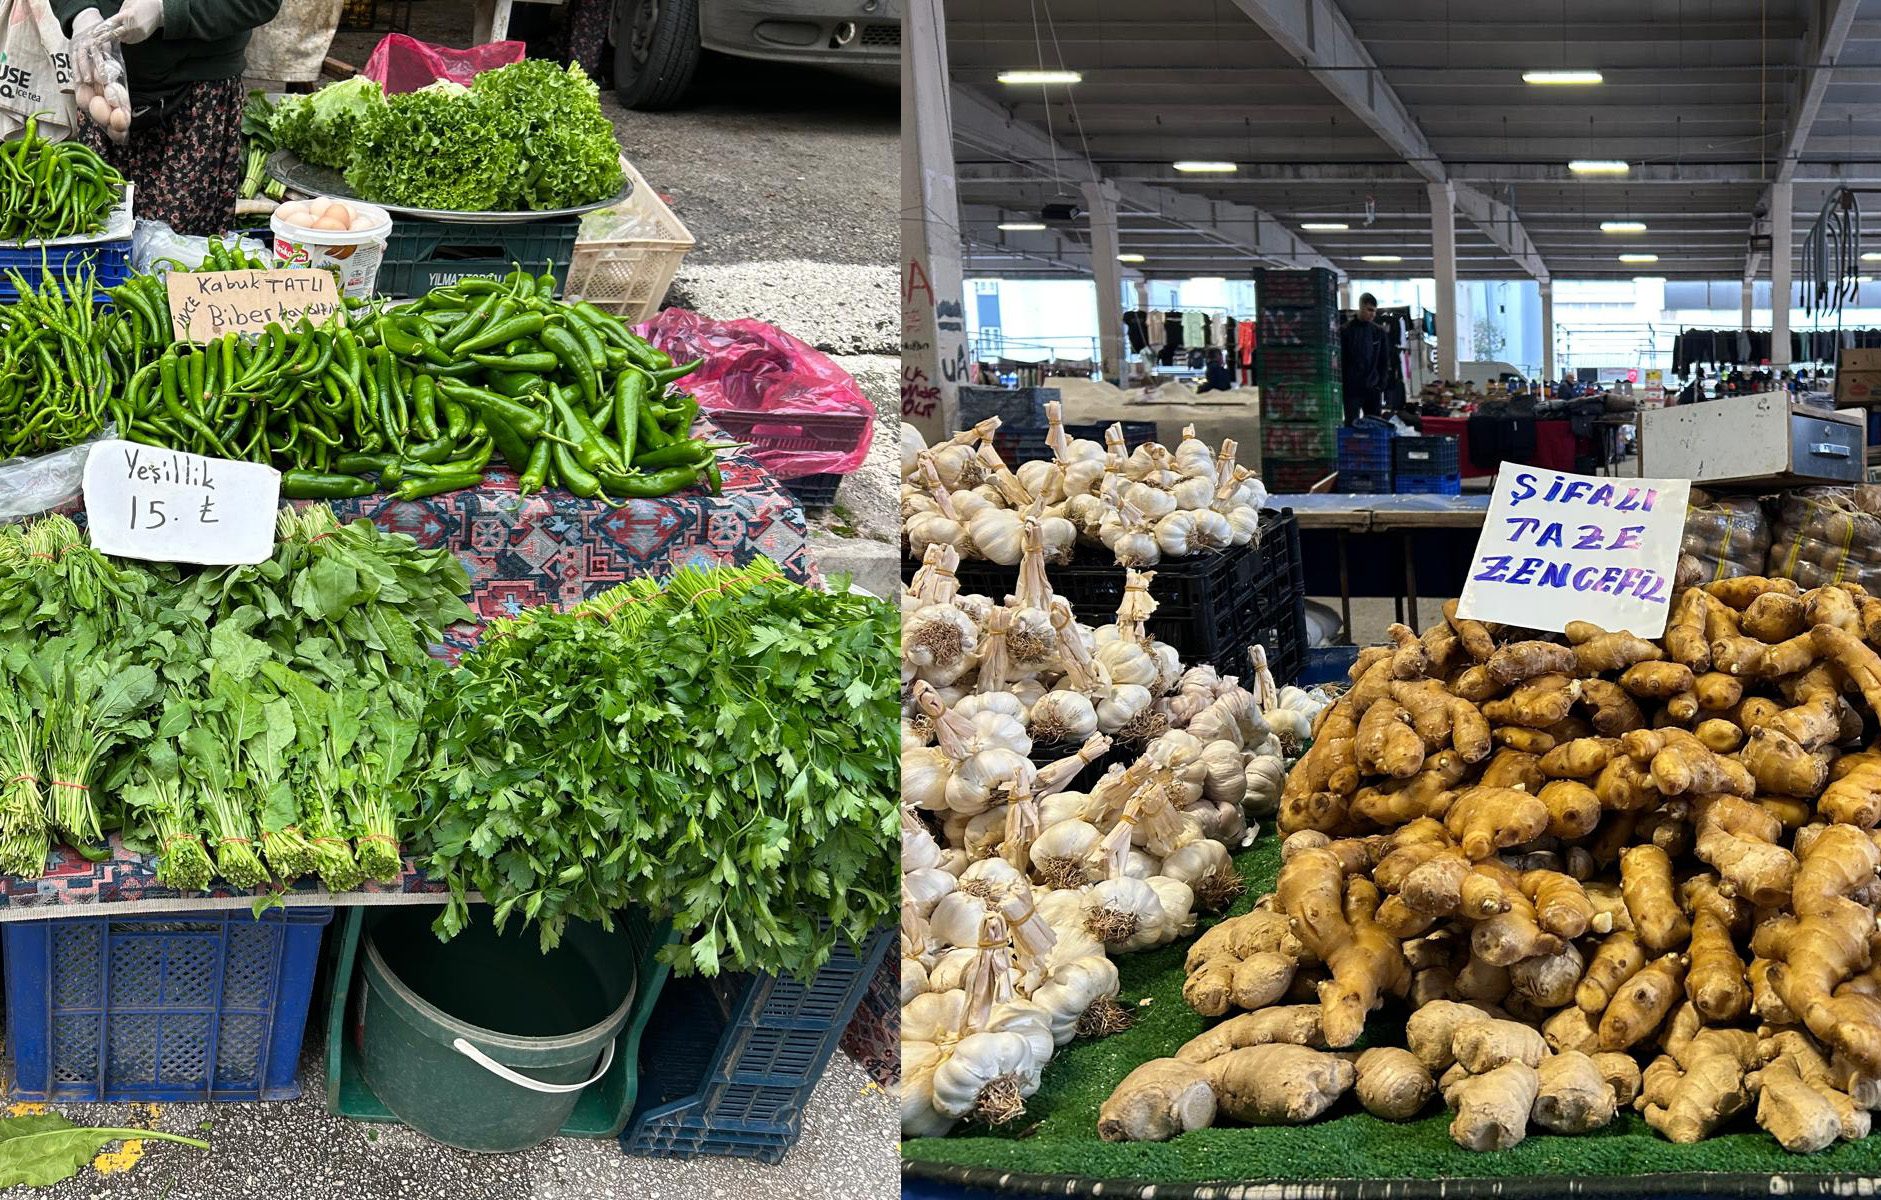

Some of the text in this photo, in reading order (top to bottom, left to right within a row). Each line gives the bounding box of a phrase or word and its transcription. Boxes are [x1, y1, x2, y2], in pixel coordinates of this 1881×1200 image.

[28, 92, 41, 103] tea
[197, 272, 323, 295] Kabuk TATLI
[208, 304, 272, 327] Biber
[125, 449, 215, 490] Yeşillik
[1510, 474, 1658, 513] ŞİFALI
[1506, 517, 1646, 551] TAZE
[1473, 555, 1667, 604] ZENCEFİL
